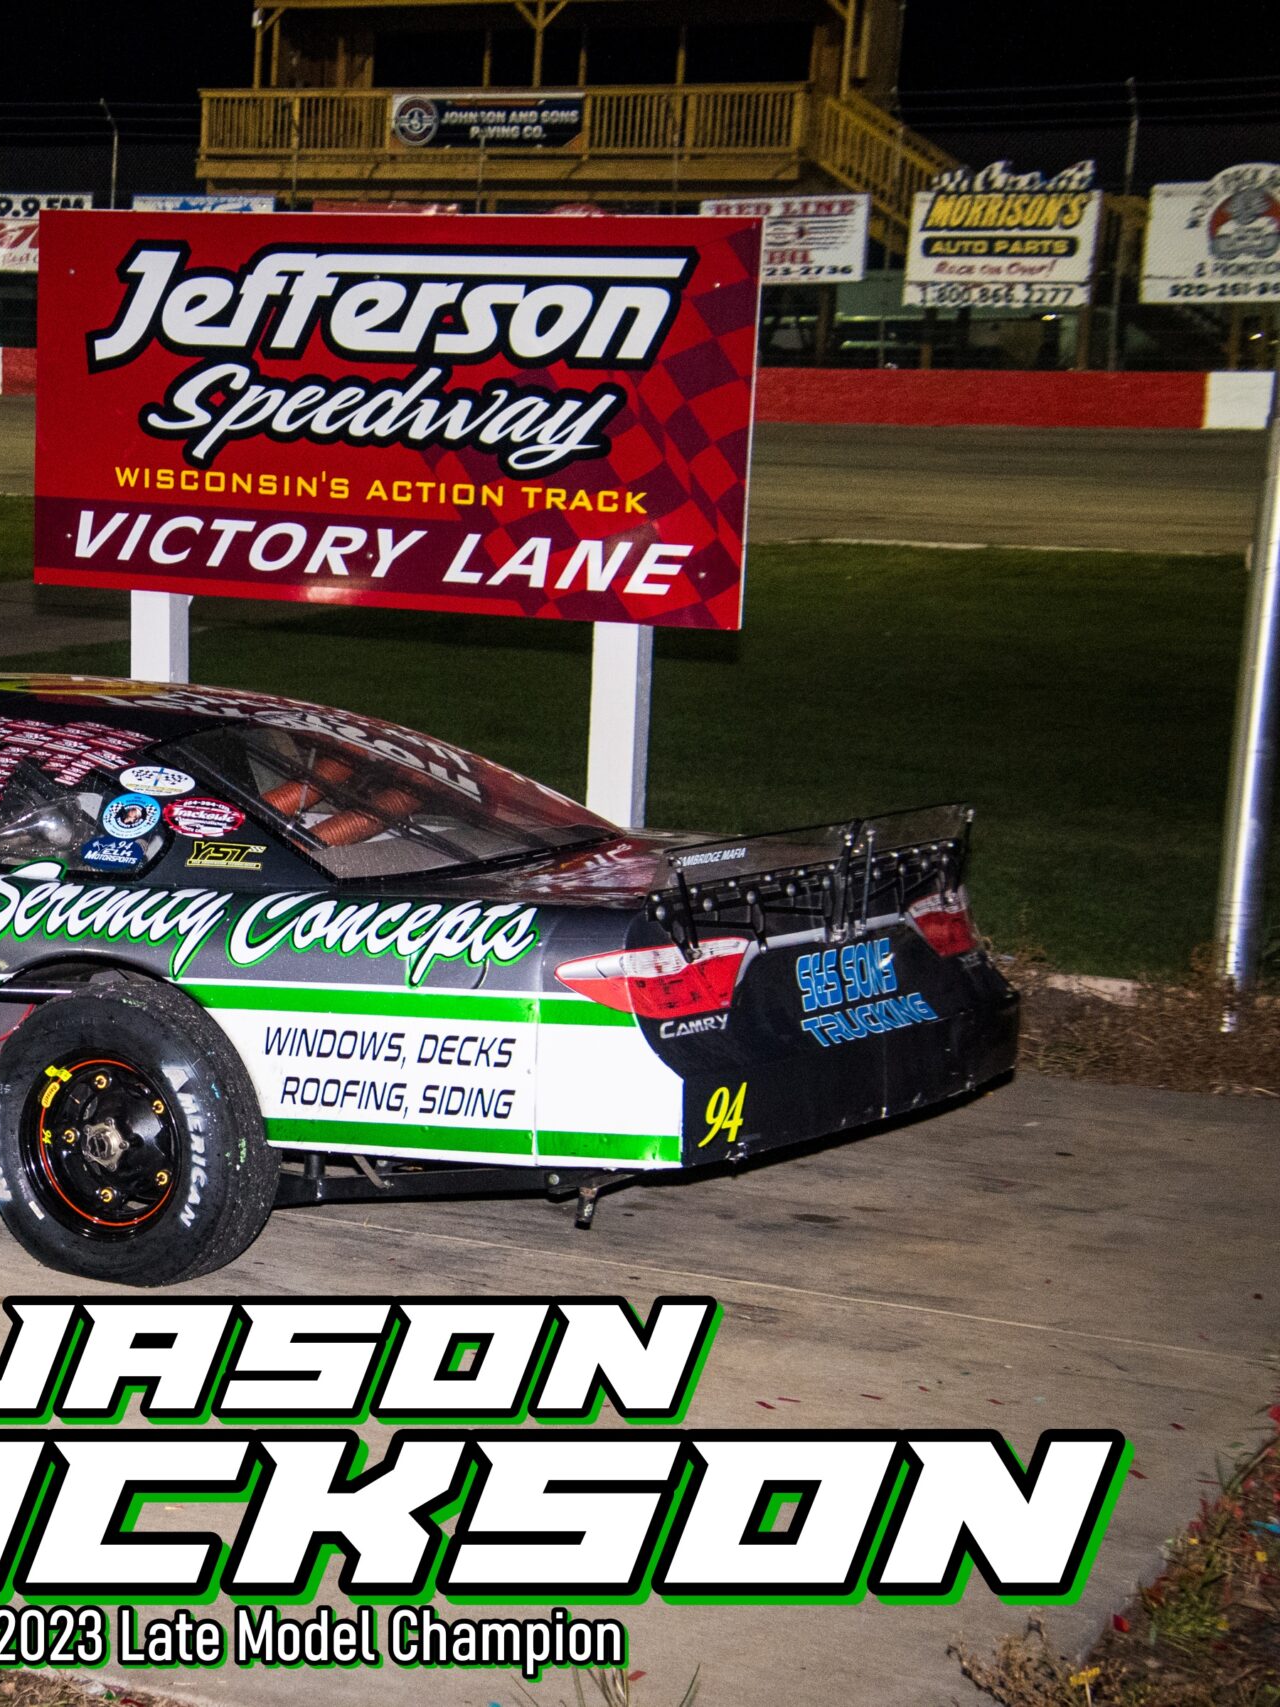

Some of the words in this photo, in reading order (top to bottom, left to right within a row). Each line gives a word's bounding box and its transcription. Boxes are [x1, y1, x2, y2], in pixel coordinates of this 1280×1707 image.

[441, 110, 505, 124] JOHNSON
[508, 110, 538, 123] AND
[540, 110, 579, 123] SONS
[470, 126, 520, 139] PVING
[714, 203, 772, 215] RED
[782, 200, 856, 216] LINE
[923, 193, 1089, 230] MORRISON'S
[929, 240, 989, 255] AUTO
[993, 240, 1069, 255] PARTS
[94, 248, 688, 363] Jefferson
[147, 363, 616, 471] Speedway
[114, 466, 351, 500] WISCONSIN'S
[366, 480, 505, 508] ACTION
[521, 486, 648, 515] TRACK
[73, 509, 428, 580] VICTORY
[441, 533, 694, 597] LANE
[102, 849, 133, 857] ELK
[721, 847, 747, 861] MAFIA
[229, 890, 537, 986] Concepts
[801, 992, 939, 1047] TRUCKING
[264, 1026, 406, 1069] WINDOWS,
[417, 1033, 517, 1068] DECKS
[280, 1076, 409, 1119] ROOFING,
[419, 1084, 516, 1119] SIDING
[697, 1082, 747, 1148] 94
